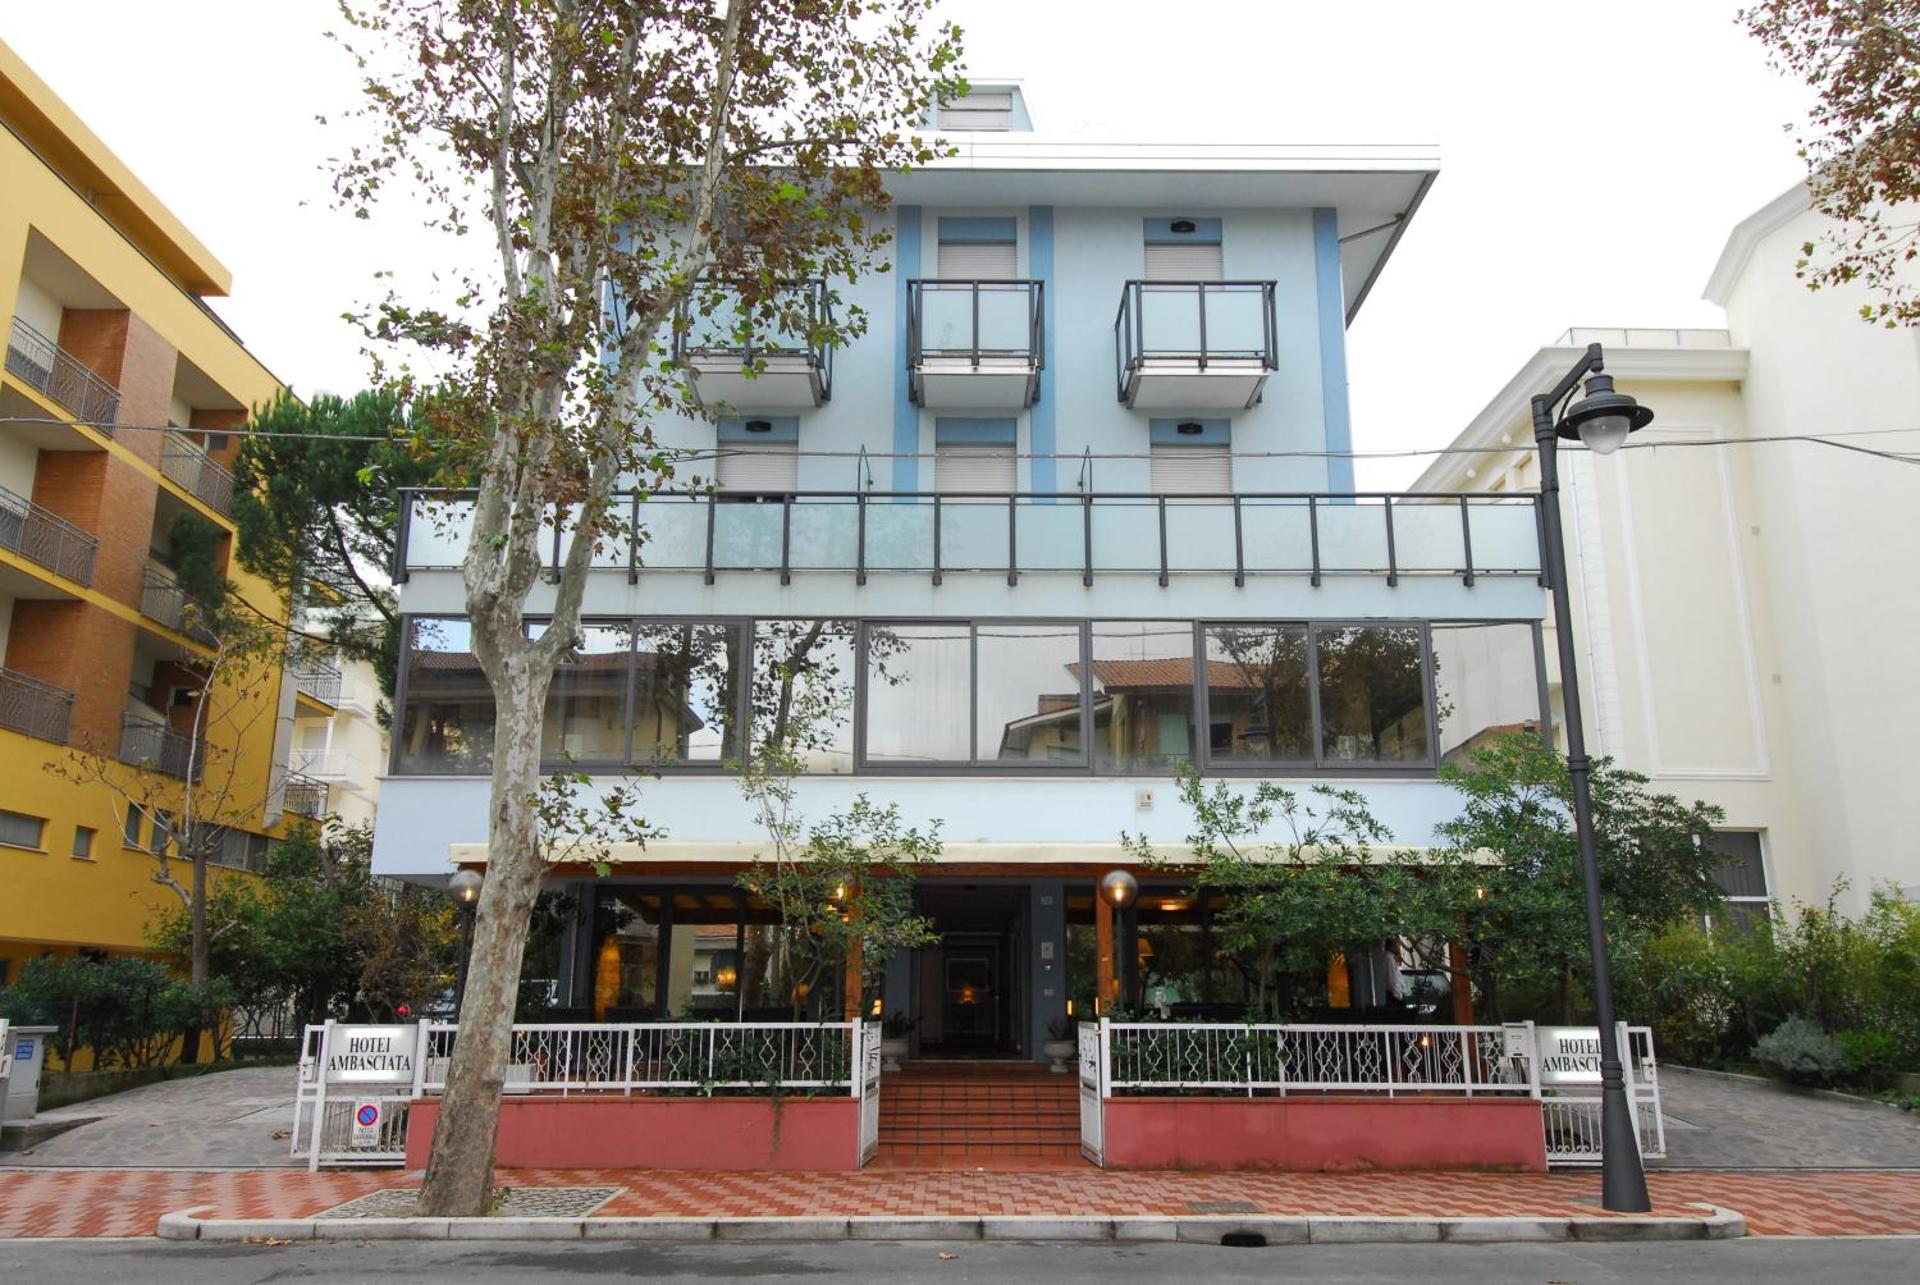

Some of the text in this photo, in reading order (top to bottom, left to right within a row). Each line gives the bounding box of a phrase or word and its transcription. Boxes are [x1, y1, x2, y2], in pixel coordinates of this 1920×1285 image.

[350, 1037, 390, 1053] HOTEL
[328, 1055, 410, 1071] AMBASCIATA
[1541, 1056, 1599, 1072] AMBASCI
